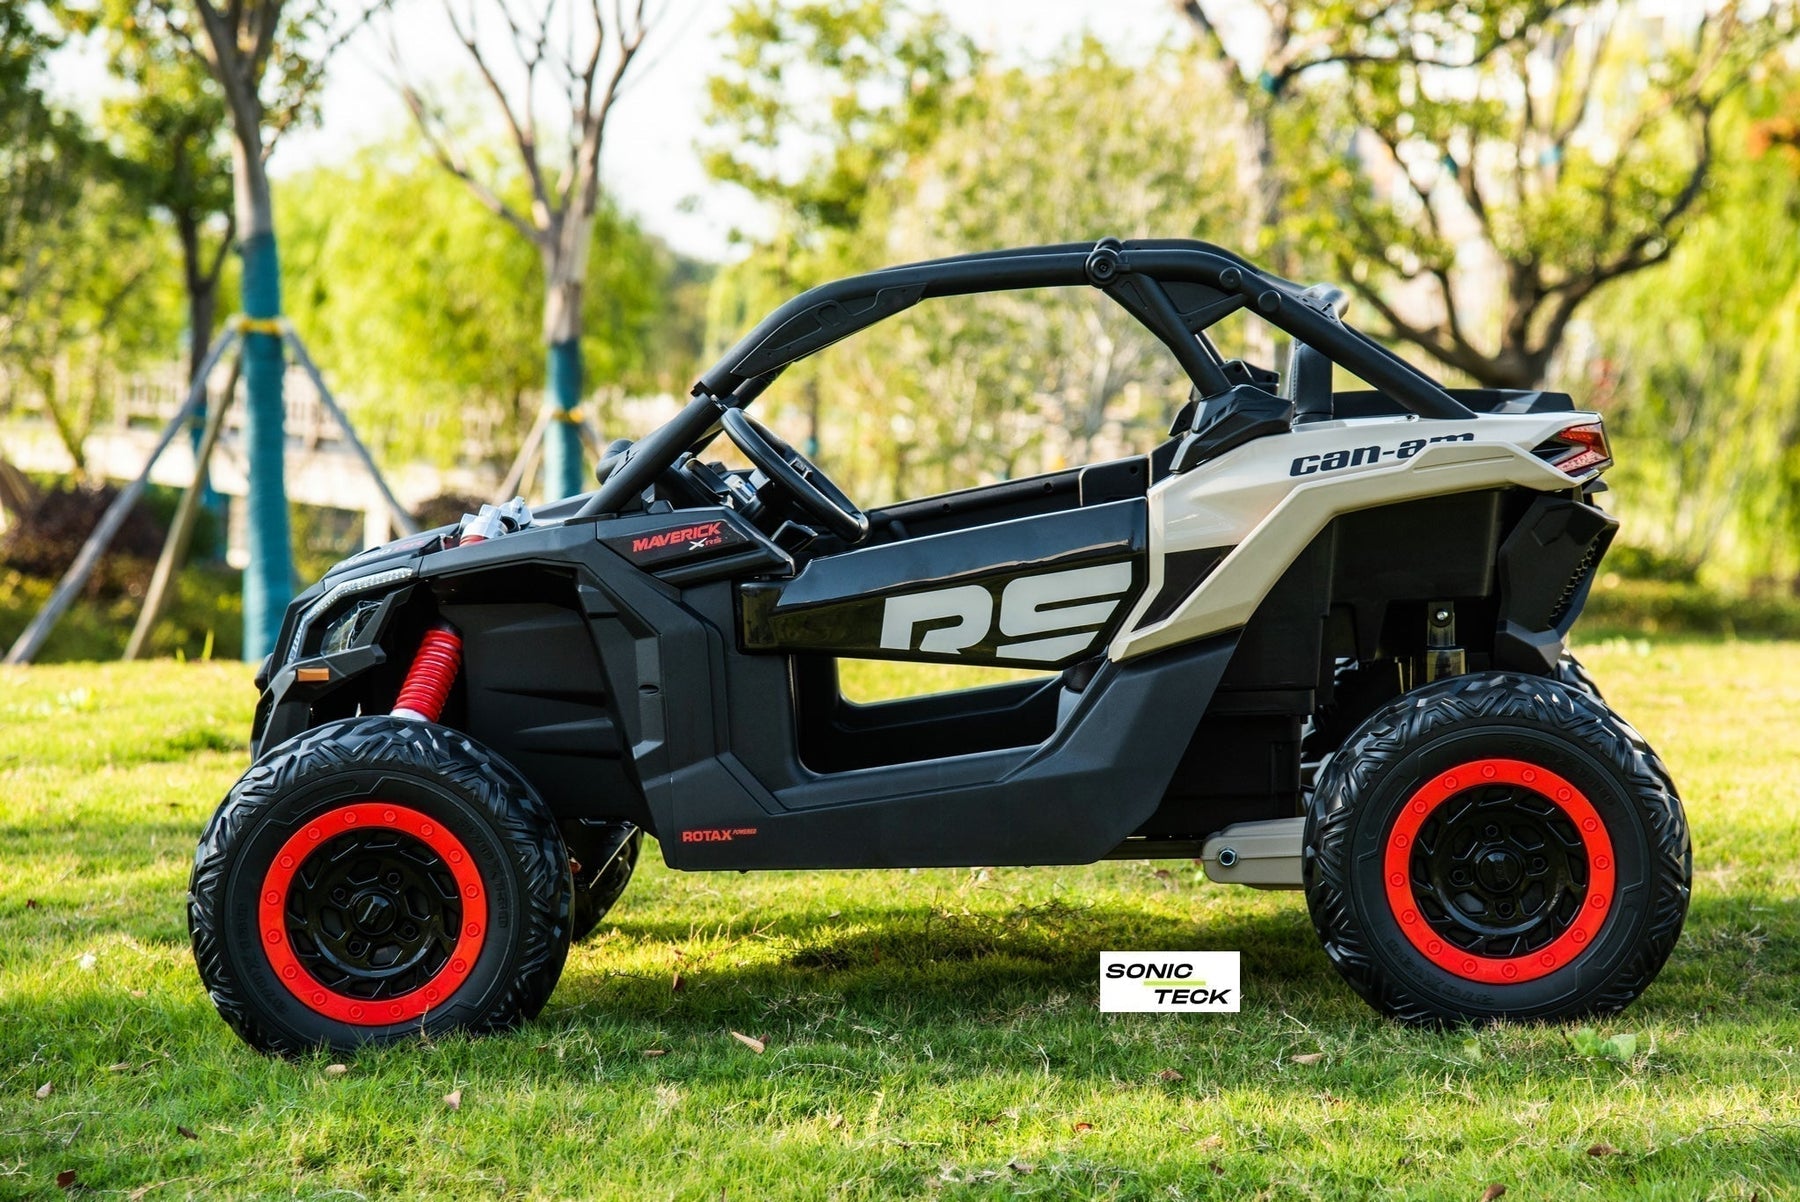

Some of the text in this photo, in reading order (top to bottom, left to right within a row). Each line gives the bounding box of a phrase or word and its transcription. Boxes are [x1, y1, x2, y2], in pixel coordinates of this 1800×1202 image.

[632, 521, 721, 552] MAVERICK
[879, 561, 1133, 662] RS
[682, 830, 732, 842] ROTAX
